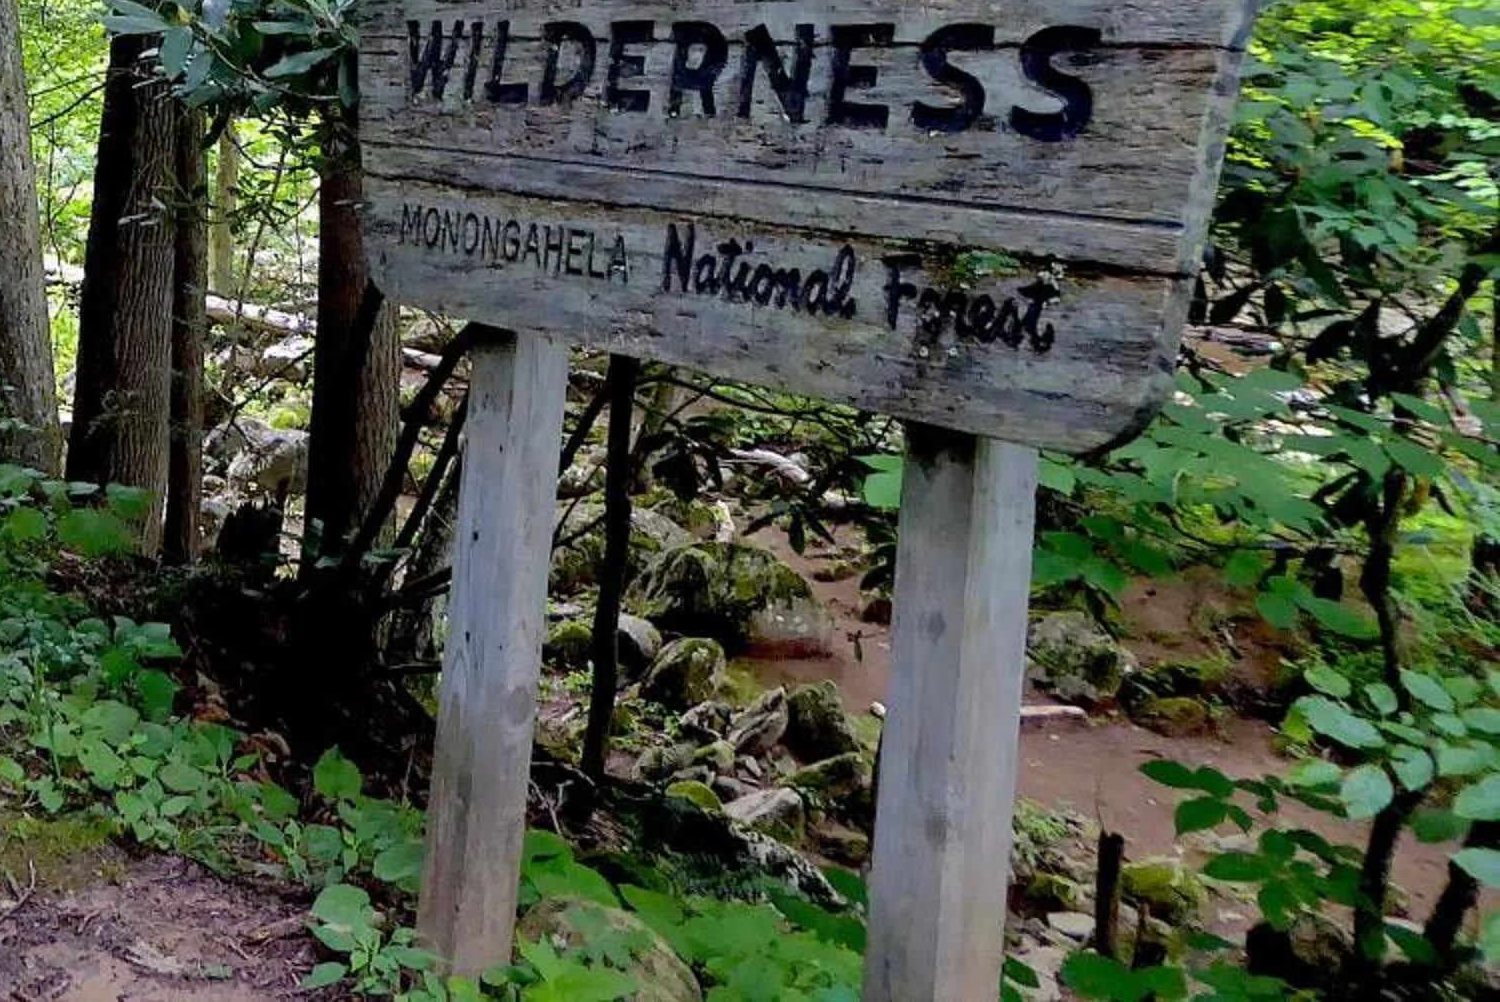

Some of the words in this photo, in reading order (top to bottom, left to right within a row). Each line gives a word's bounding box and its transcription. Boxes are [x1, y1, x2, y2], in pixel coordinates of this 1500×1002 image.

[406, 19, 1102, 142] WILDERNESS
[399, 202, 630, 285] MONONGAHELA
[660, 222, 857, 320] National
